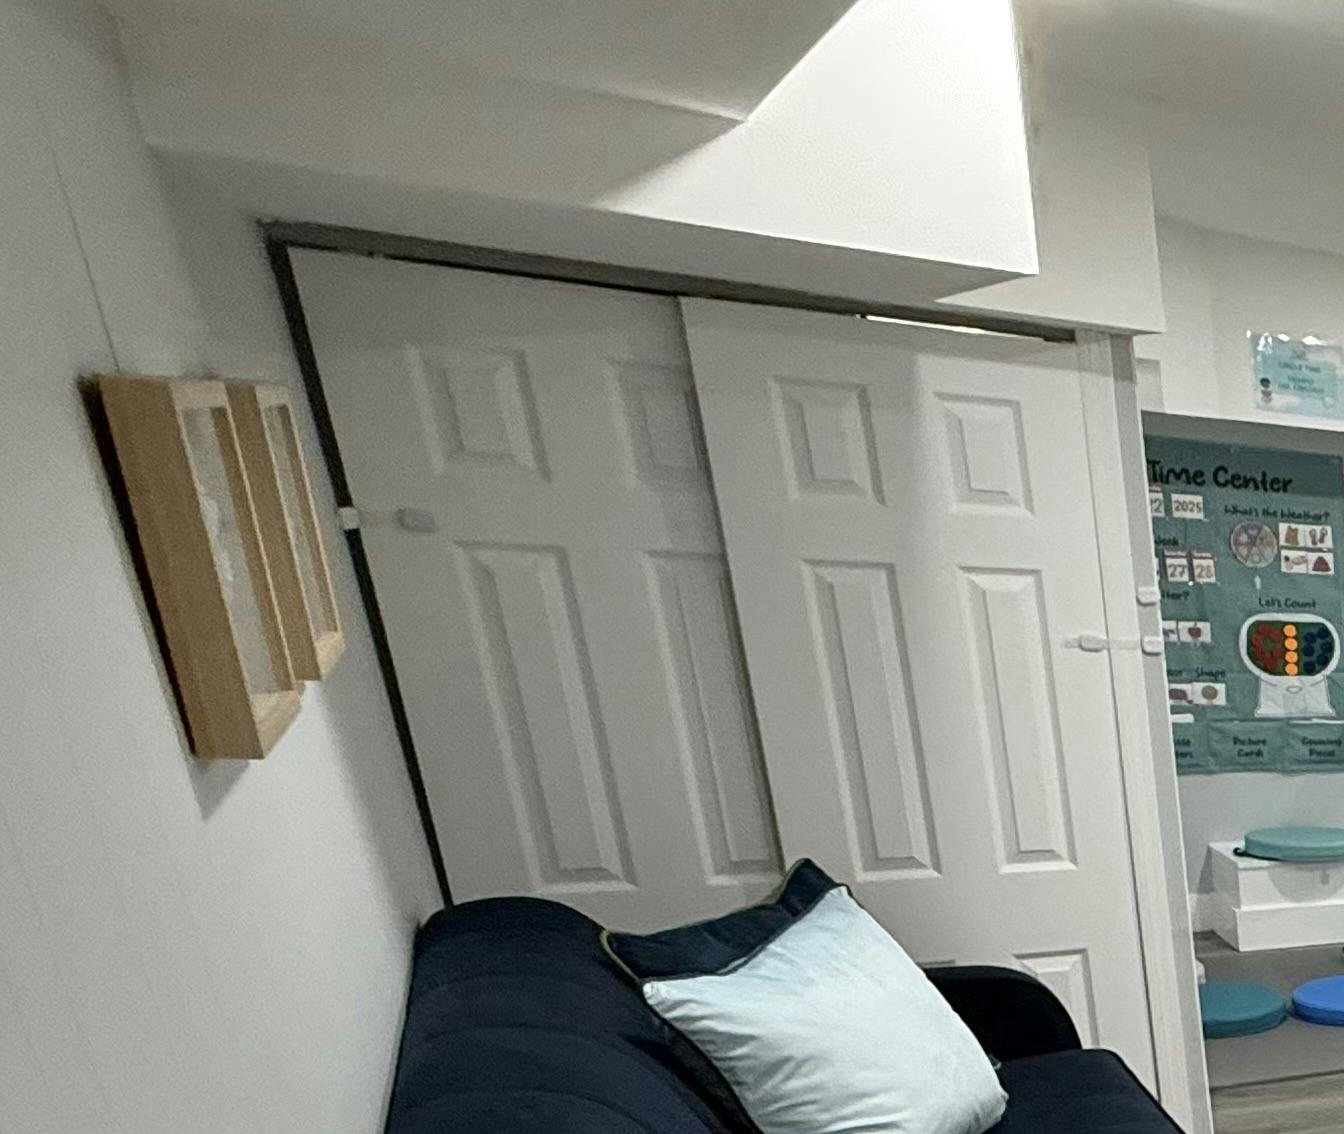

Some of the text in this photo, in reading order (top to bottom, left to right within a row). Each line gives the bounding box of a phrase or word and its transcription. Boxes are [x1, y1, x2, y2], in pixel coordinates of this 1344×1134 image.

[1147, 459, 1293, 493] Time Center
[1173, 500, 1202, 514] 2025
[1224, 503, 1330, 521] What's the Weather?
[1167, 563, 1187, 578] 27
[1195, 564, 1213, 579] 28
[1258, 597, 1316, 609] Let's Count
